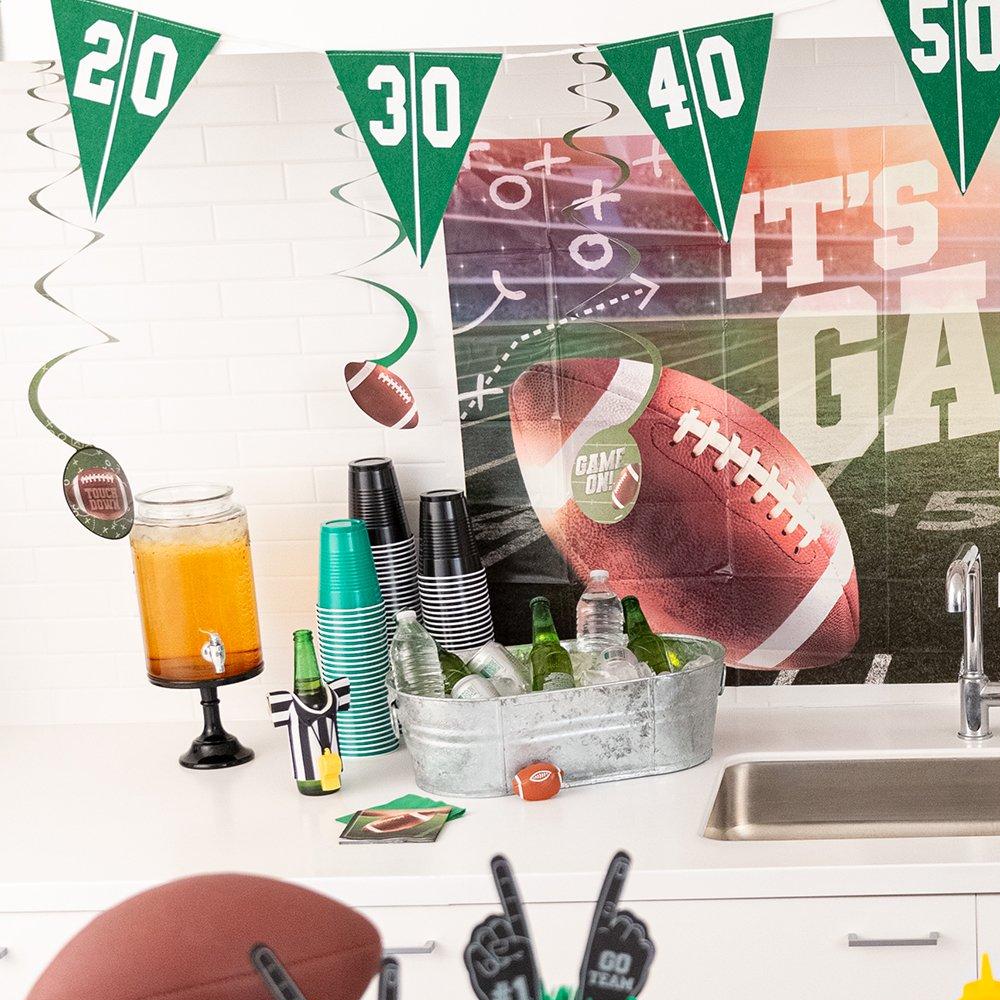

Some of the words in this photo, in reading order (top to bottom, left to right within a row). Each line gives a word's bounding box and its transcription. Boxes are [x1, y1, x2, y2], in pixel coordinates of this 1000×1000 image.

[73, 20, 179, 117] 20
[647, 35, 745, 129] 40
[368, 64, 460, 148] 30
[726, 159, 939, 299] IT'S
[576, 448, 625, 475] GAME
[84, 488, 118, 500] TOUCH
[586, 472, 613, 495] ON!
[89, 498, 120, 511] DOWN
[598, 950, 632, 975] GO
[588, 970, 635, 991] TEAM
